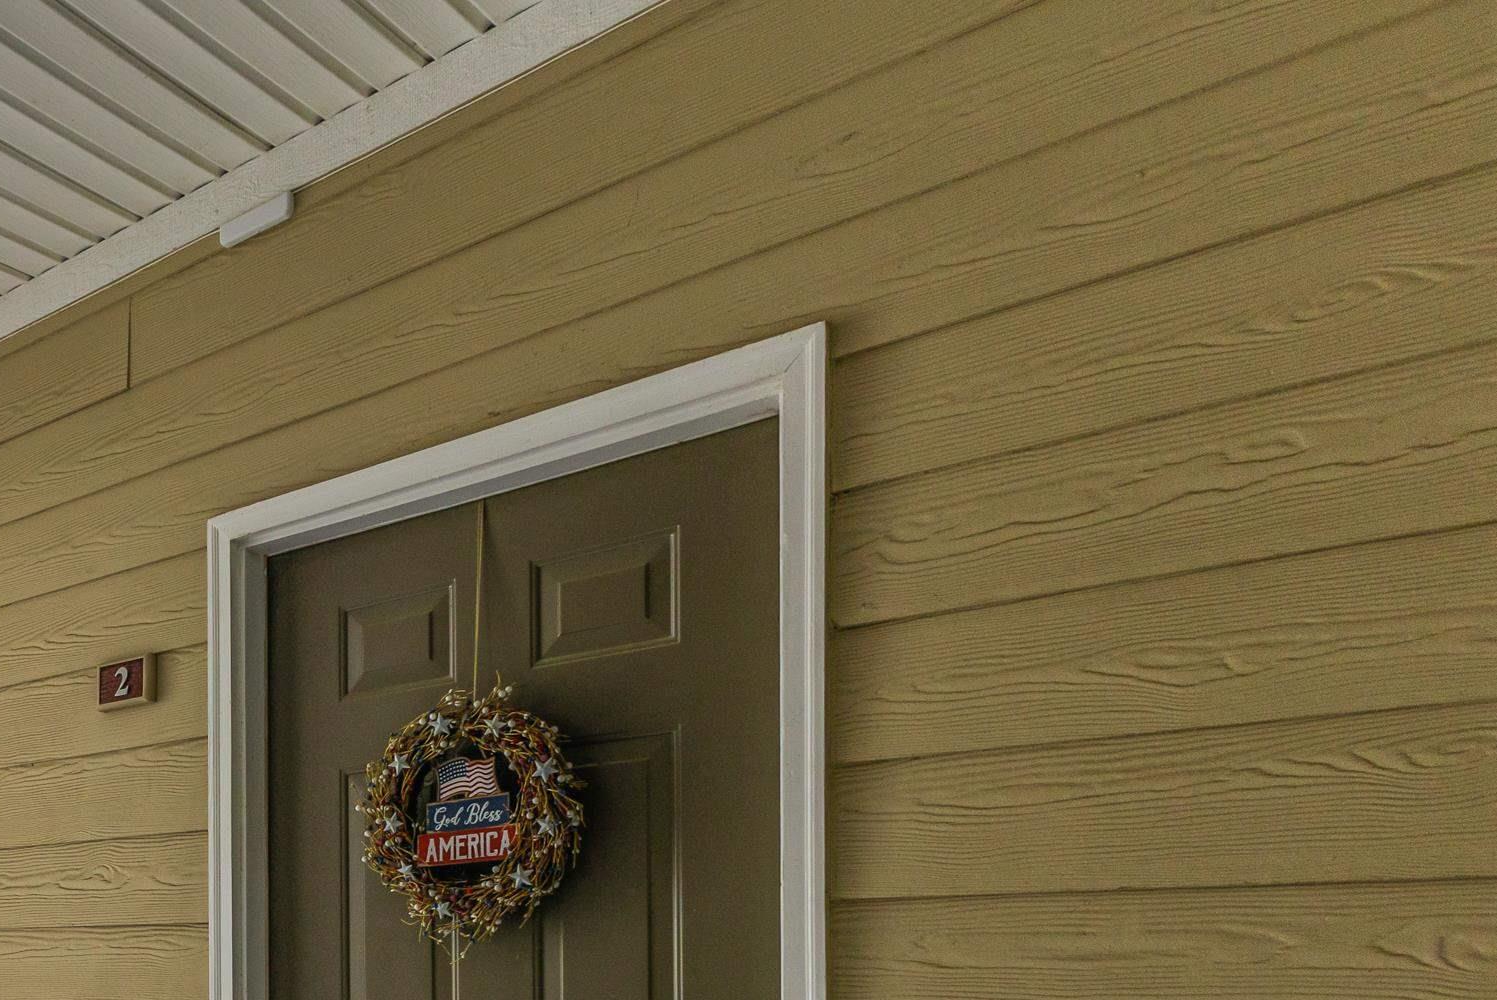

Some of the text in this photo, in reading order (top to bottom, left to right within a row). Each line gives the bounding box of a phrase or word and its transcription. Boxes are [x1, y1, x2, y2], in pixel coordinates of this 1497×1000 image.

[114, 666, 129, 697] 2
[434, 801, 502, 830] God Bless
[427, 830, 510, 862] AMERICA
